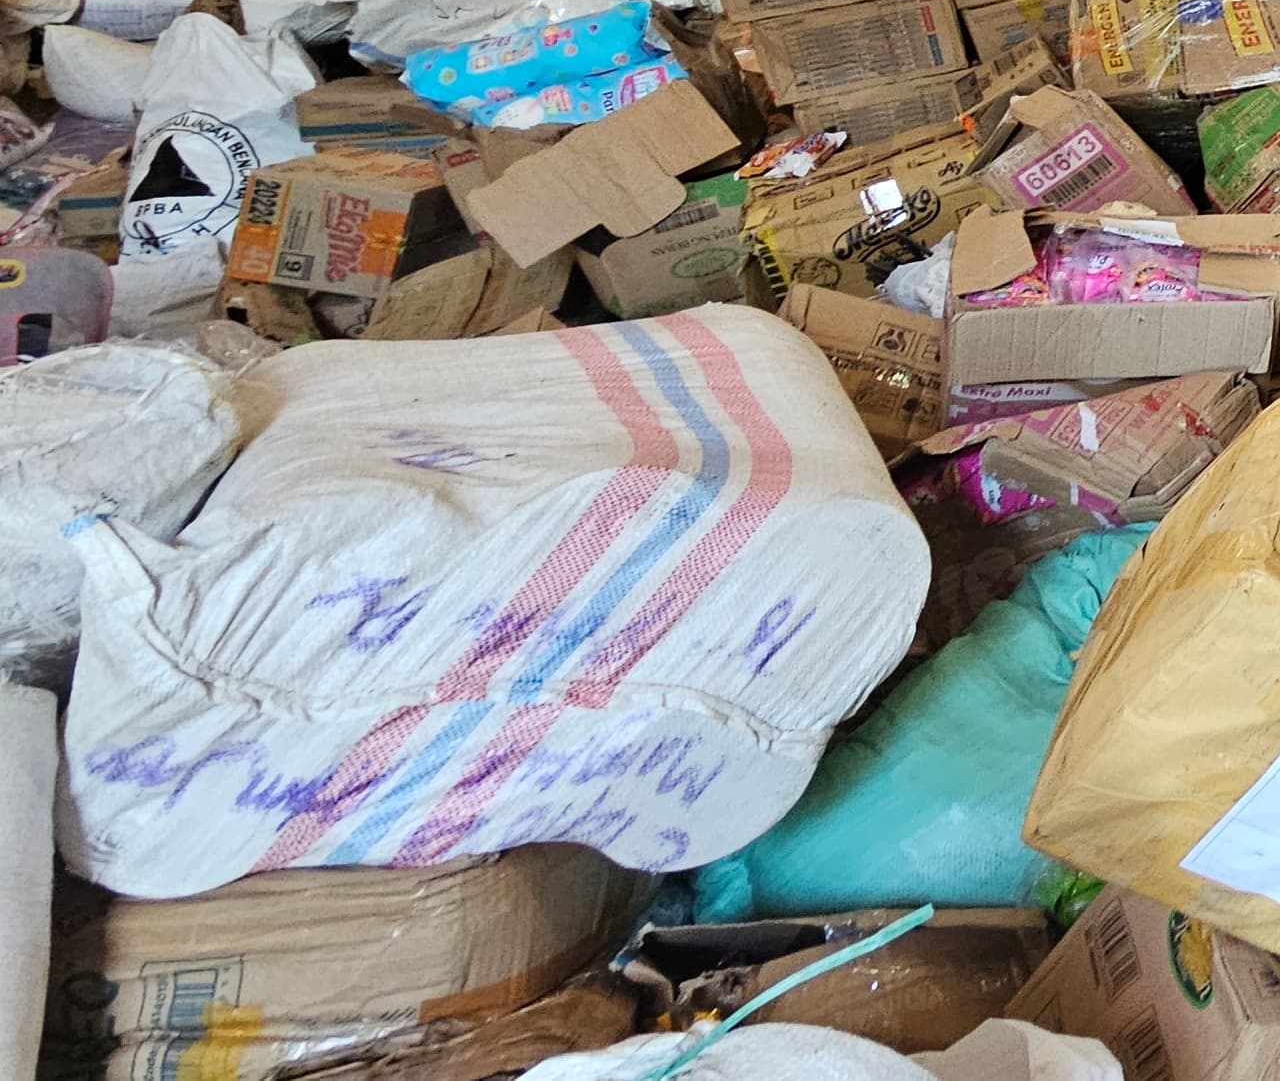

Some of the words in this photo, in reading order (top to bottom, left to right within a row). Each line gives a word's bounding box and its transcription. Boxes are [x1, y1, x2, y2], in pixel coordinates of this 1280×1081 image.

[1099, 1, 1127, 71] ENERGEN
[1022, 132, 1101, 194] 60613
[1006, 383, 1053, 399] Maxi
